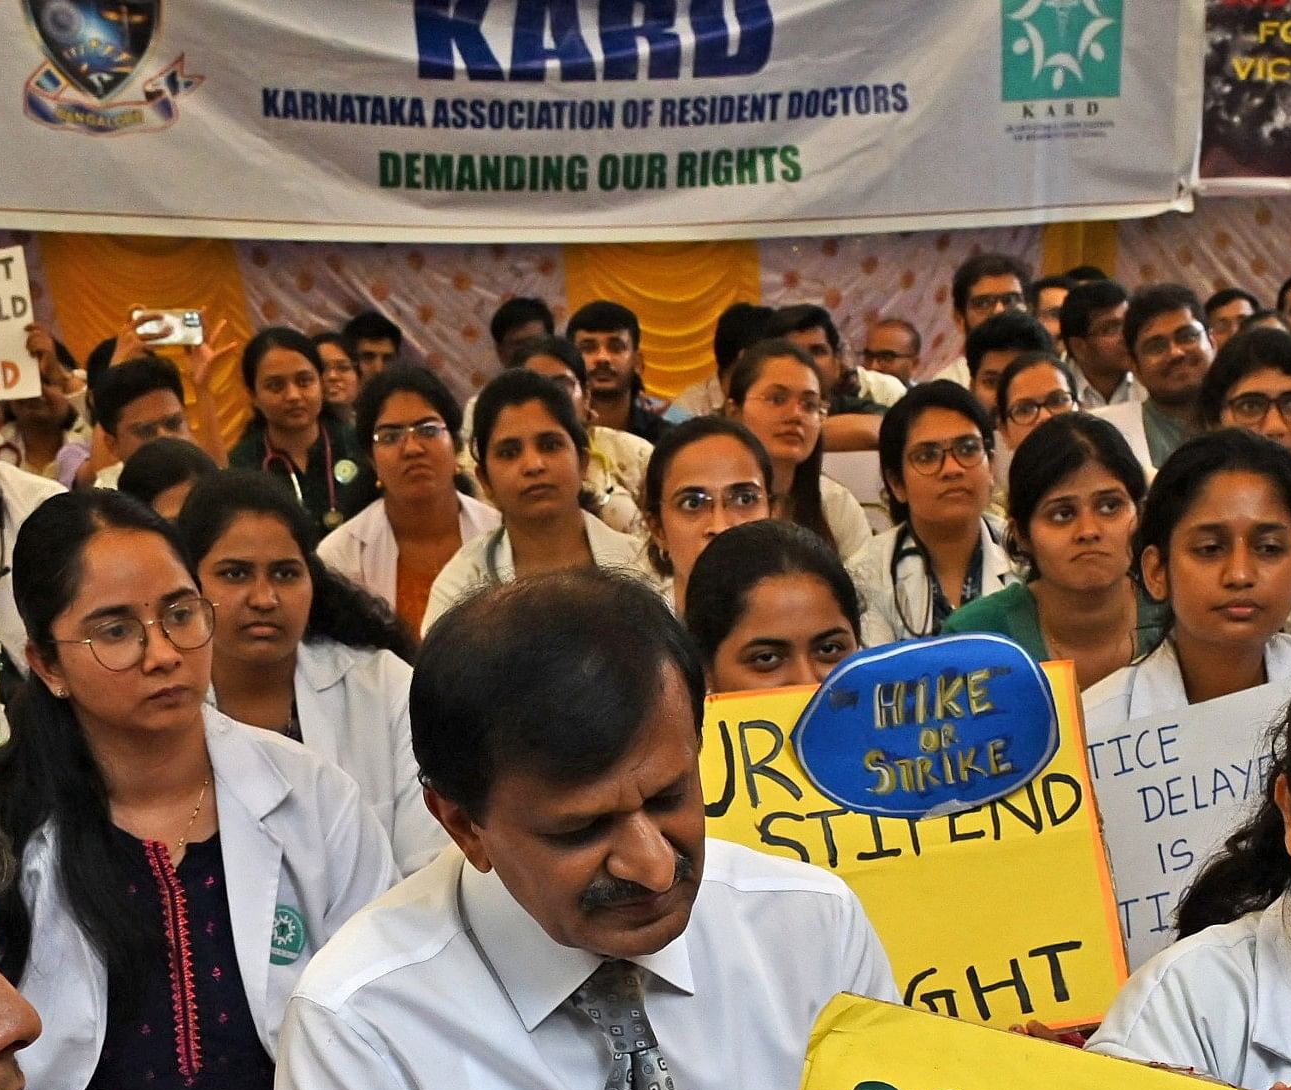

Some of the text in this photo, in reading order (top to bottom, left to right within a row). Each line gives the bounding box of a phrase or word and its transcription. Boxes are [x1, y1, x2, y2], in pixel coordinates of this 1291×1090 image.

[262, 83, 909, 131] KARNATAKA ASSOCIATION OF RESIDENT DOCTORS
[379, 145, 804, 192] DEMANDING OUR RIGHTS
[874, 667, 995, 729] HIKE
[918, 723, 958, 754] OR
[863, 737, 1014, 797] STRIKE
[1157, 838, 1194, 874] IS
